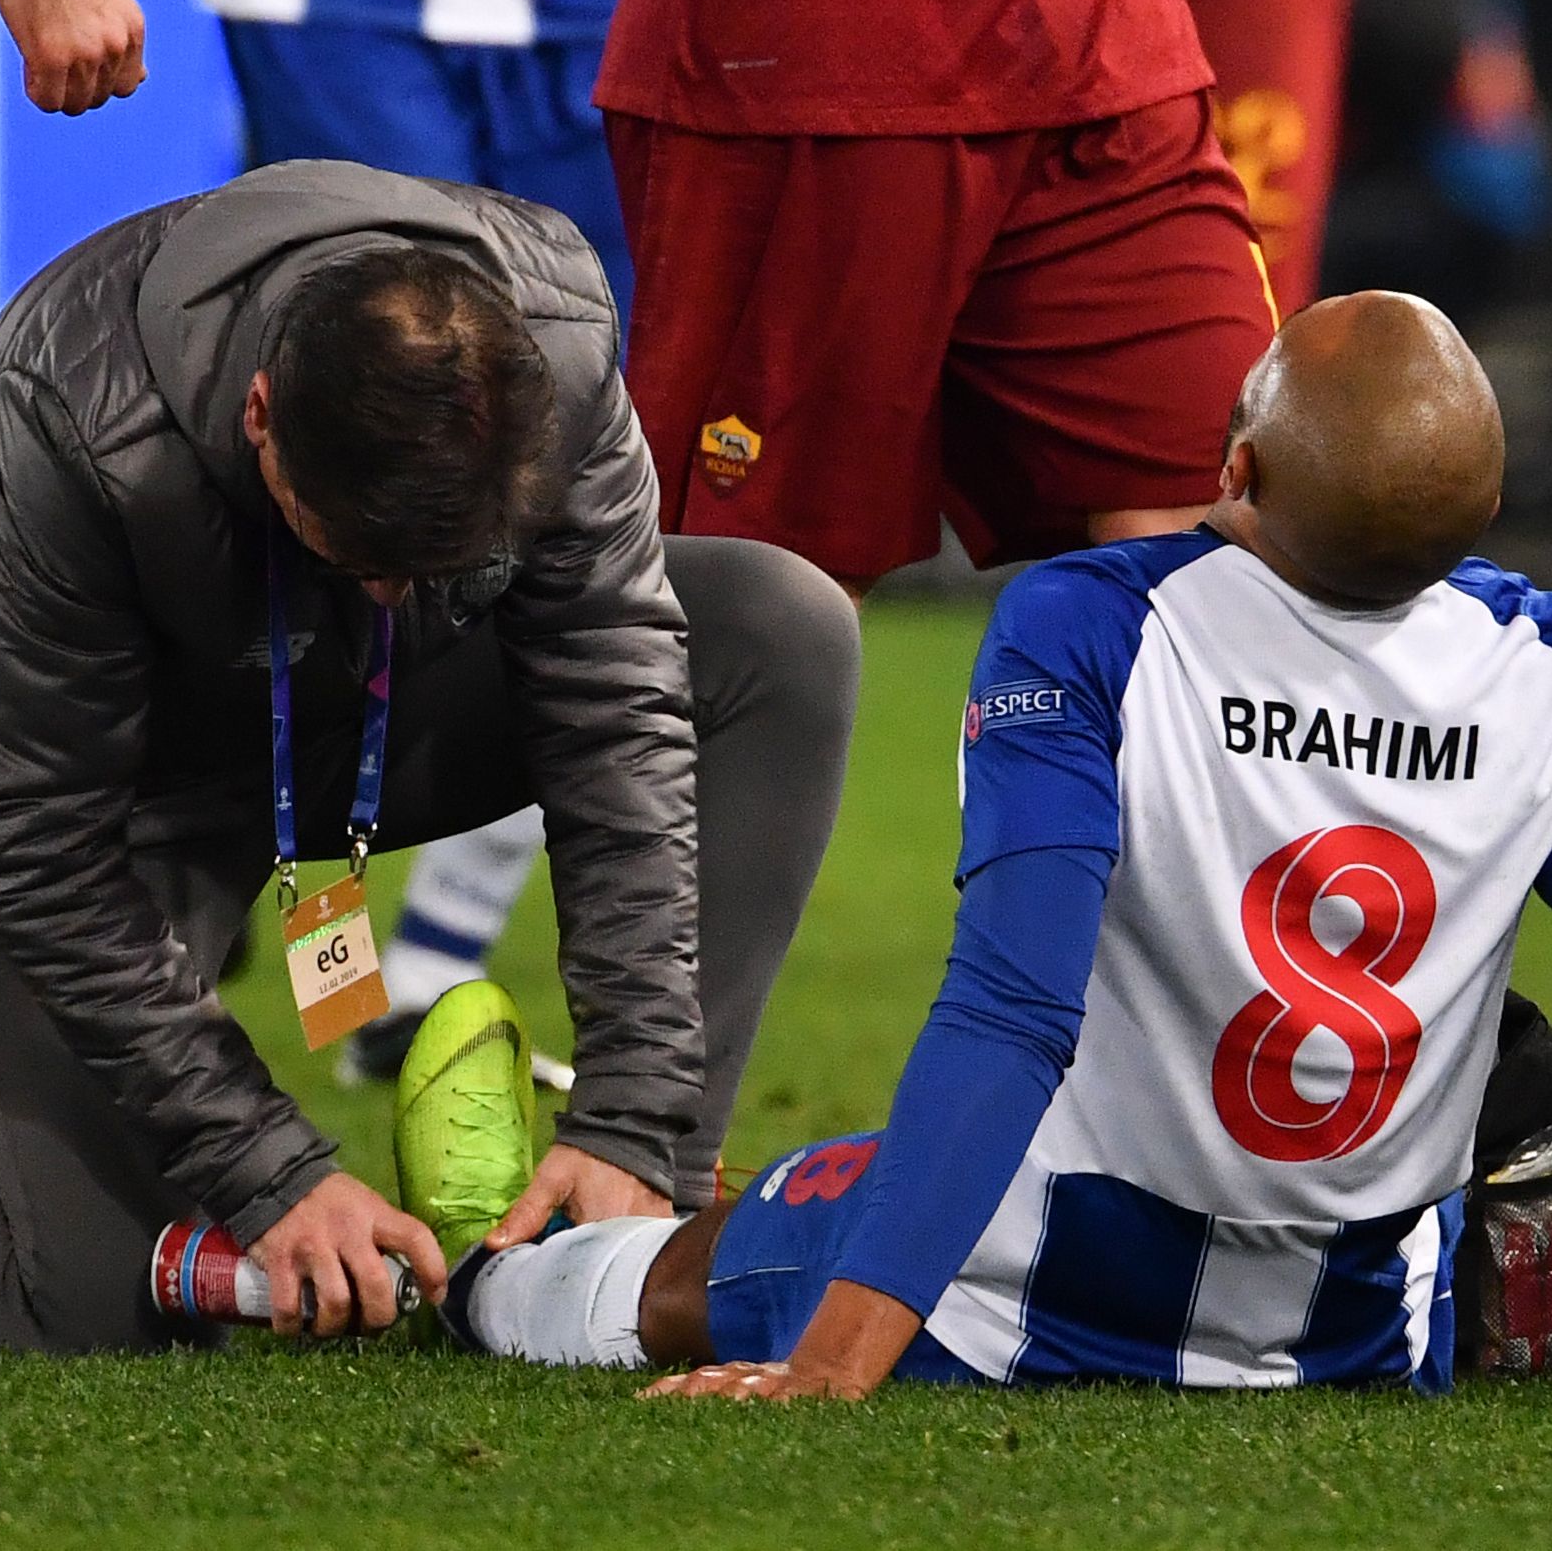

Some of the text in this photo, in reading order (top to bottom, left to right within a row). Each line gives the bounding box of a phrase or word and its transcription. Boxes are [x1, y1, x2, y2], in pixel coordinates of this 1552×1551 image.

[1220, 695, 1480, 781] BRAHIMI
[317, 934, 349, 973] eG
[1212, 824, 1436, 1162] 8
